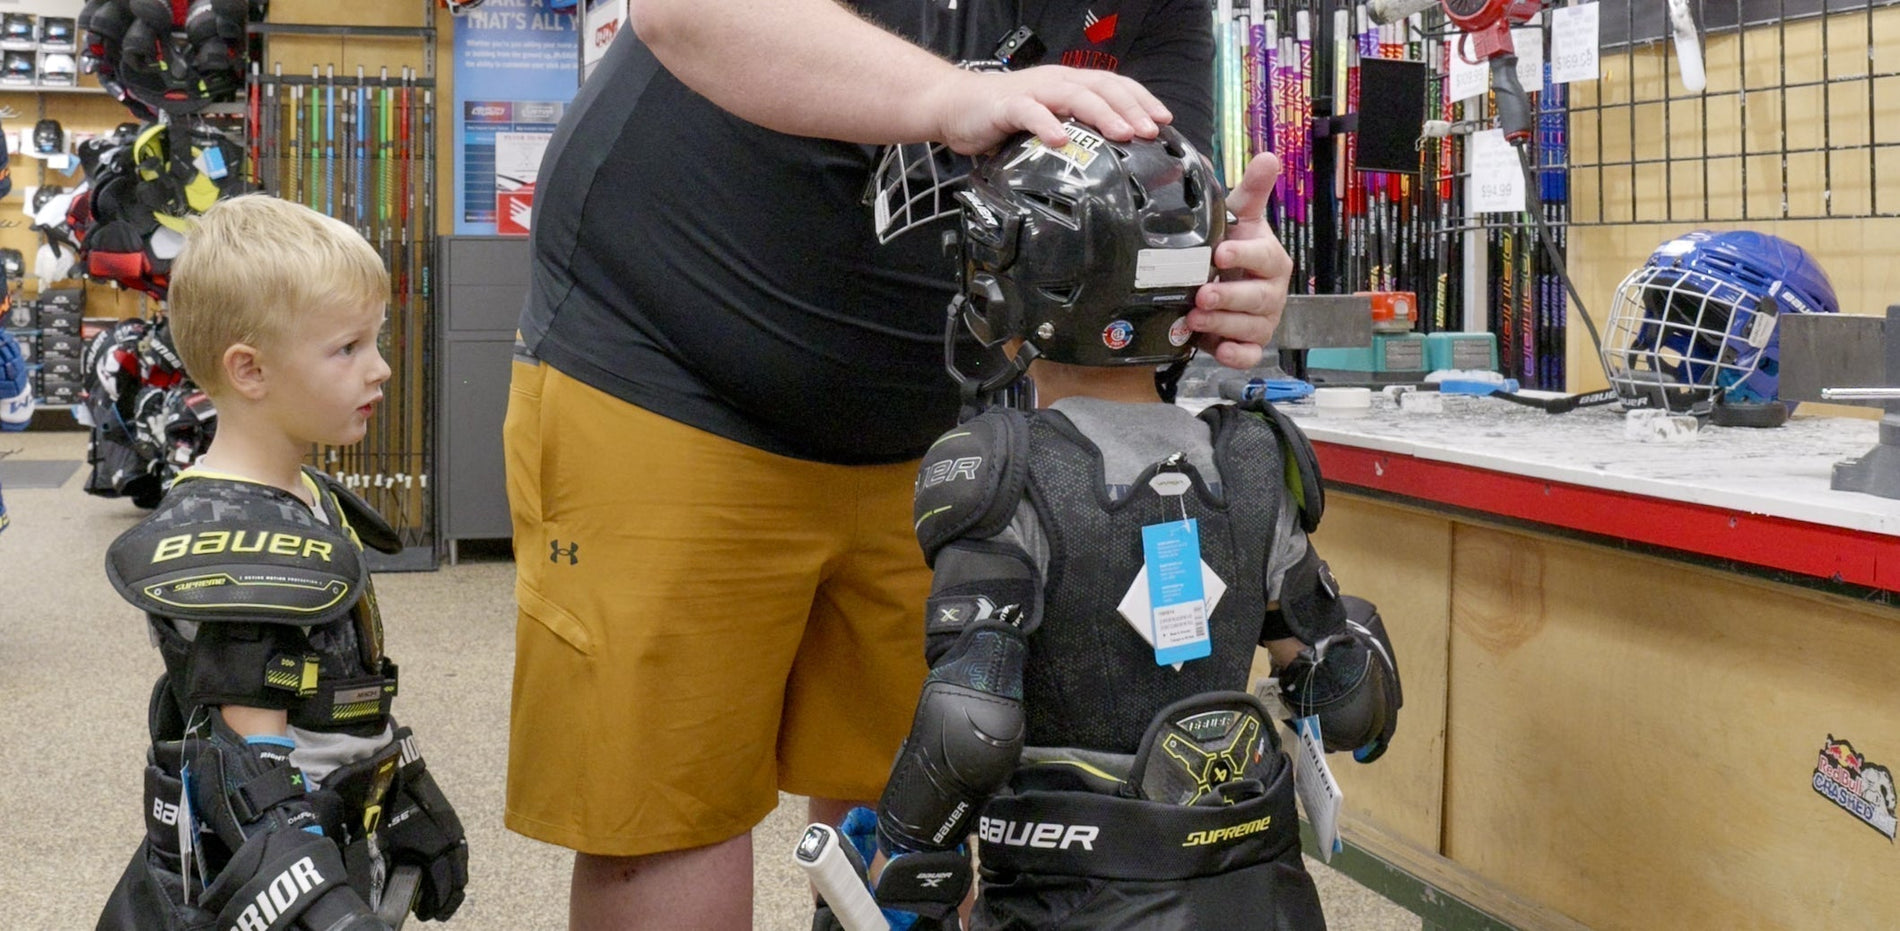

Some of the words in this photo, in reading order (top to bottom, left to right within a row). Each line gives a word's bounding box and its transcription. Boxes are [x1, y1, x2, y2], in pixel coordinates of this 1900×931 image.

[467, 13, 526, 30] THAT'S
[532, 14, 563, 31] ALL
[1579, 390, 1618, 404] BAUE
[151, 530, 333, 564] BAUER
[173, 578, 226, 592] SUPREME
[1814, 774, 1875, 820] CRASHED
[933, 801, 969, 844] BAUER
[979, 816, 1100, 851] BAUER
[1182, 815, 1271, 847] SUPREME
